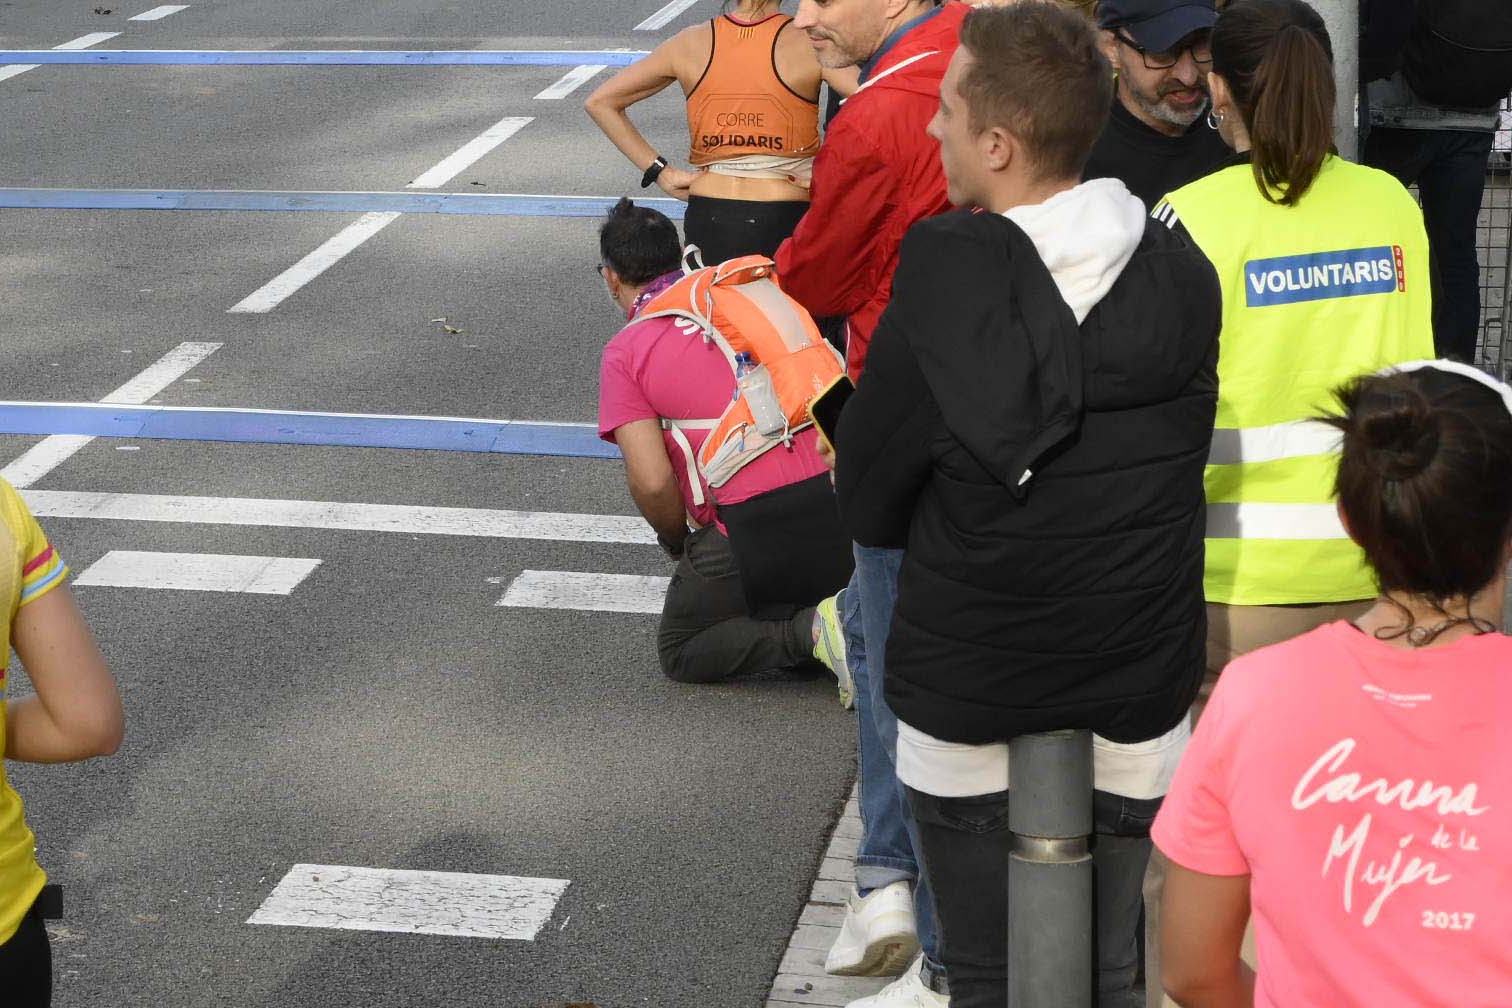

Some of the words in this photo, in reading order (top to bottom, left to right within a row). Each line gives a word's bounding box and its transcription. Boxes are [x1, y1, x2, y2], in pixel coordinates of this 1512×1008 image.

[716, 112, 765, 128] CORRE
[701, 134, 784, 150] SOLIDARIS
[1250, 258, 1393, 295] VOLUNTARIS
[1291, 738, 1491, 816] Carrera
[1321, 813, 1452, 927] Mujer
[1421, 910, 1476, 930] 2017
